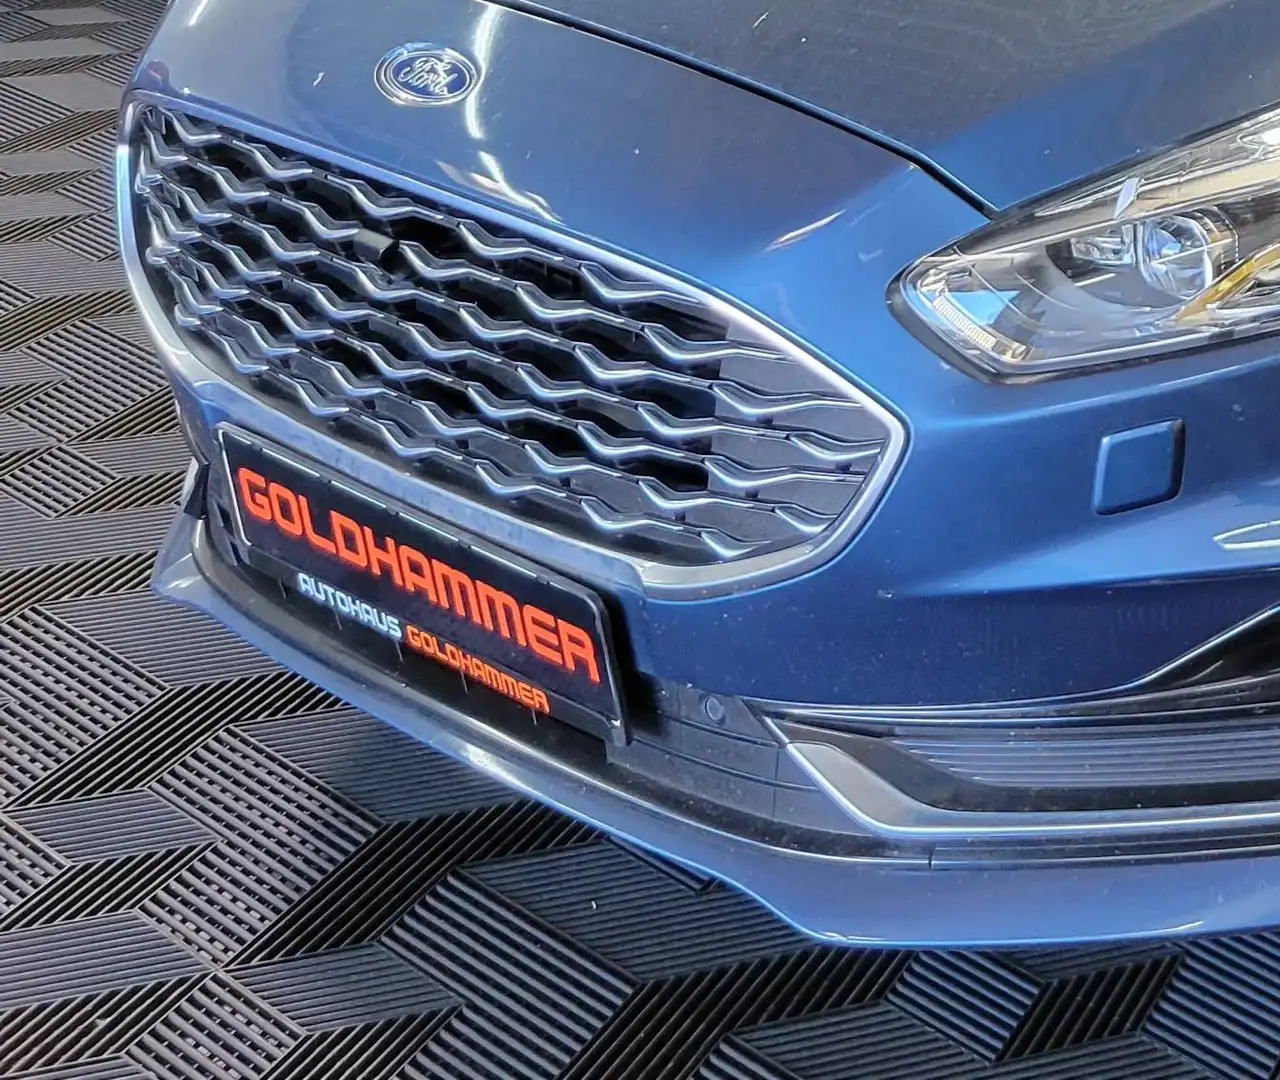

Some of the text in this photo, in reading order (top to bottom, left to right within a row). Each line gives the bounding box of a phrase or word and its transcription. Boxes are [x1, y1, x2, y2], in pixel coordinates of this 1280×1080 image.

[398, 57, 459, 95] Ford
[236, 466, 601, 684] GOLDHAMMER
[297, 572, 551, 714] AUTOHAUS GOLDHAMMER
